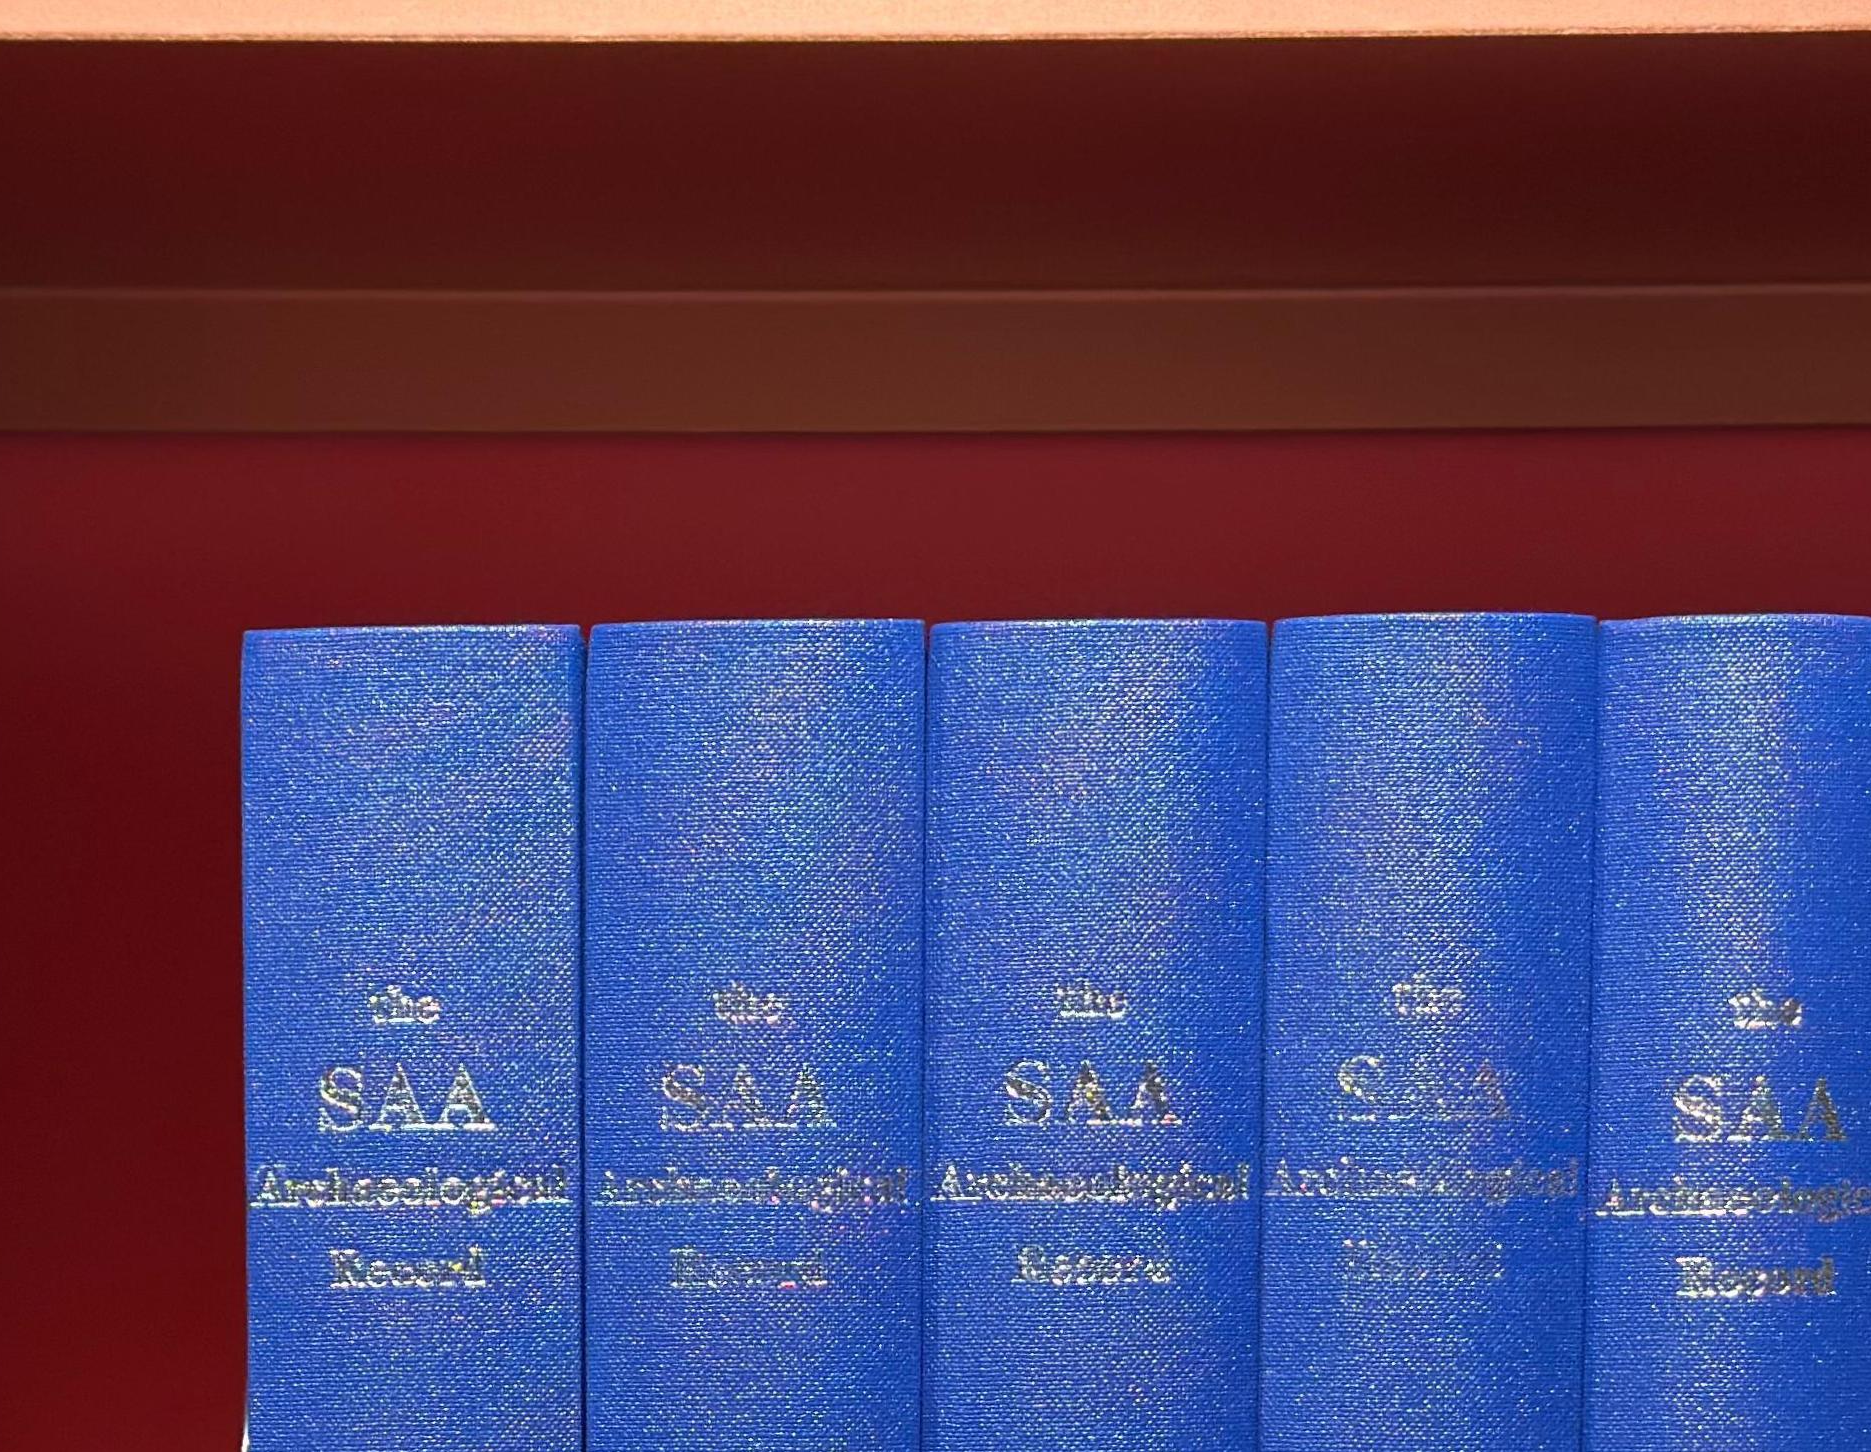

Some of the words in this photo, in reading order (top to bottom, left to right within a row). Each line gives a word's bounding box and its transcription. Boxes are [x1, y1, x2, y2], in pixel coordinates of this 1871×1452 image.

[368, 983, 441, 1025] the
[319, 1060, 496, 1132] SAA
[661, 1061, 837, 1130] SAA
[1004, 1058, 1182, 1126] SAA
[1673, 1075, 1847, 1143] SAA
[249, 1163, 569, 1215] Archaeological
[329, 1244, 486, 1290] Record
